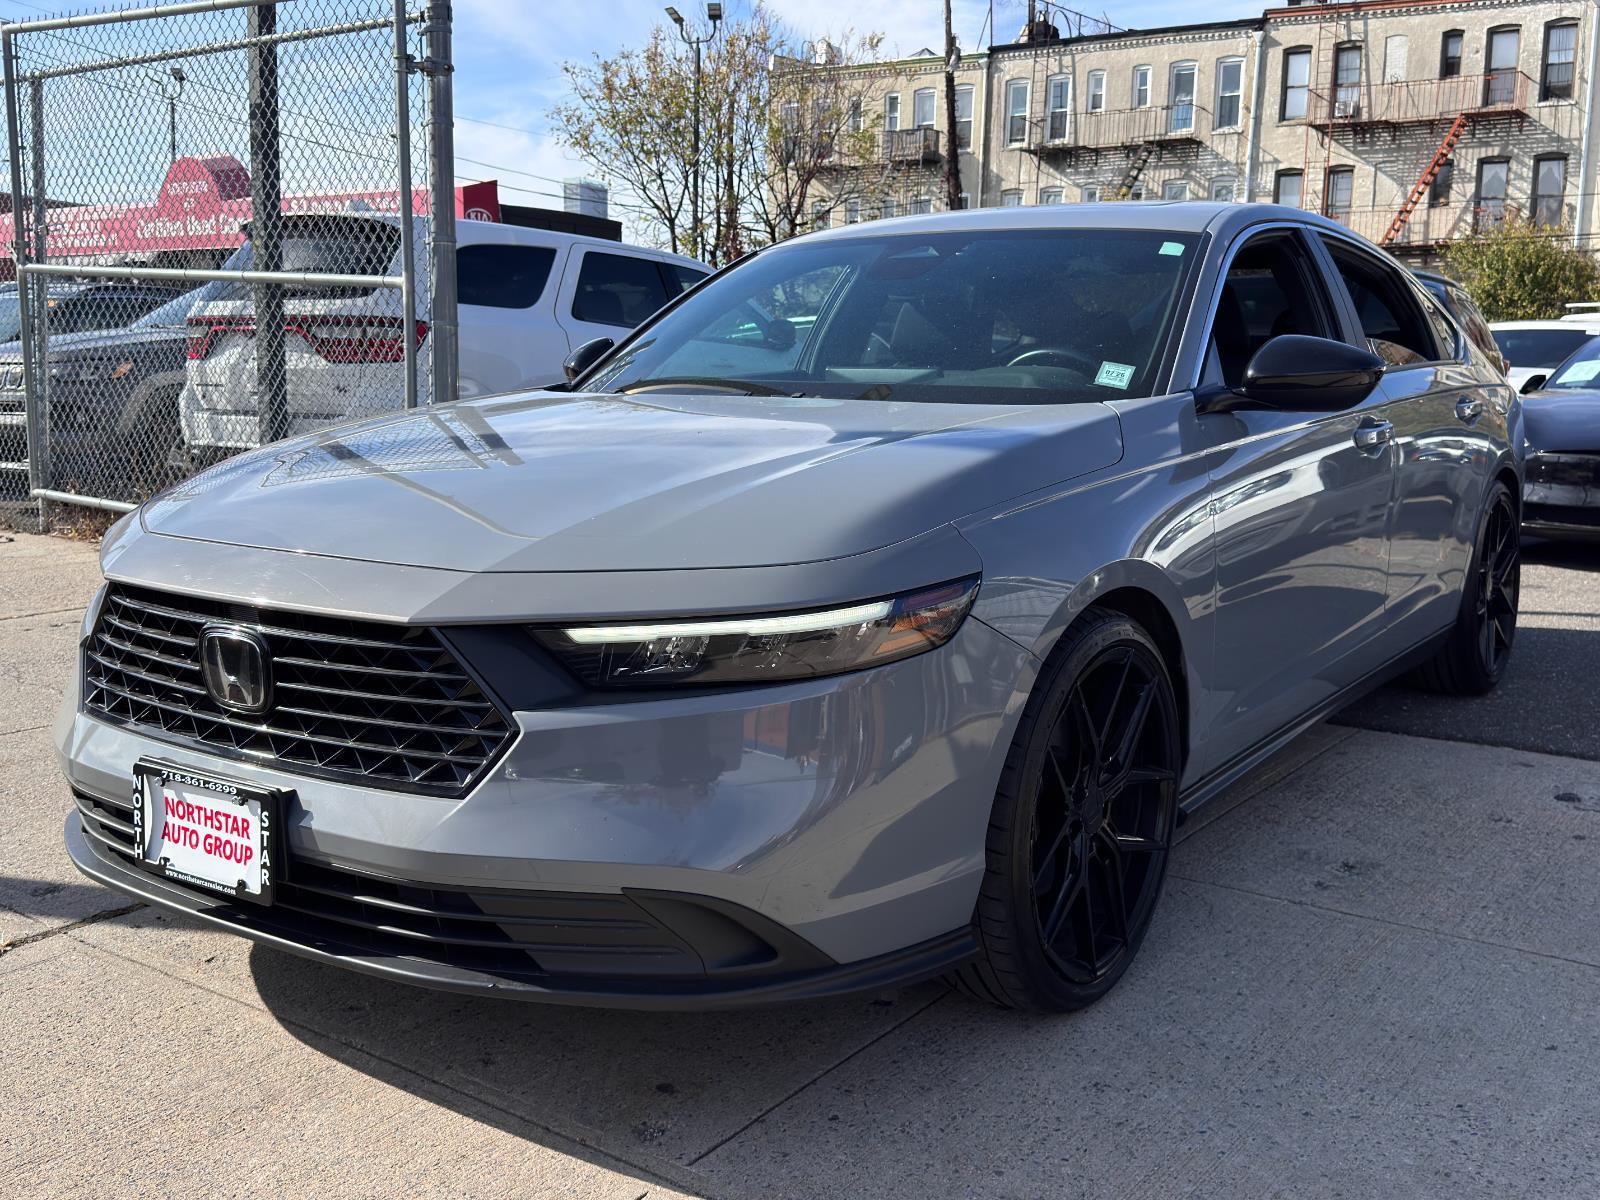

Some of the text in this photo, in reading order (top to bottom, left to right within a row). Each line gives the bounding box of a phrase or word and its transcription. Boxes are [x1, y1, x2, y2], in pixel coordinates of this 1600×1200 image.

[470, 211, 488, 222] KIA
[132, 775, 143, 860] NORTH
[164, 796, 251, 840] NORTHSTAR
[161, 821, 254, 867] AUTO GROUP
[260, 811, 271, 886] STAR
[164, 868, 237, 896] www.northstarcarsales.com
